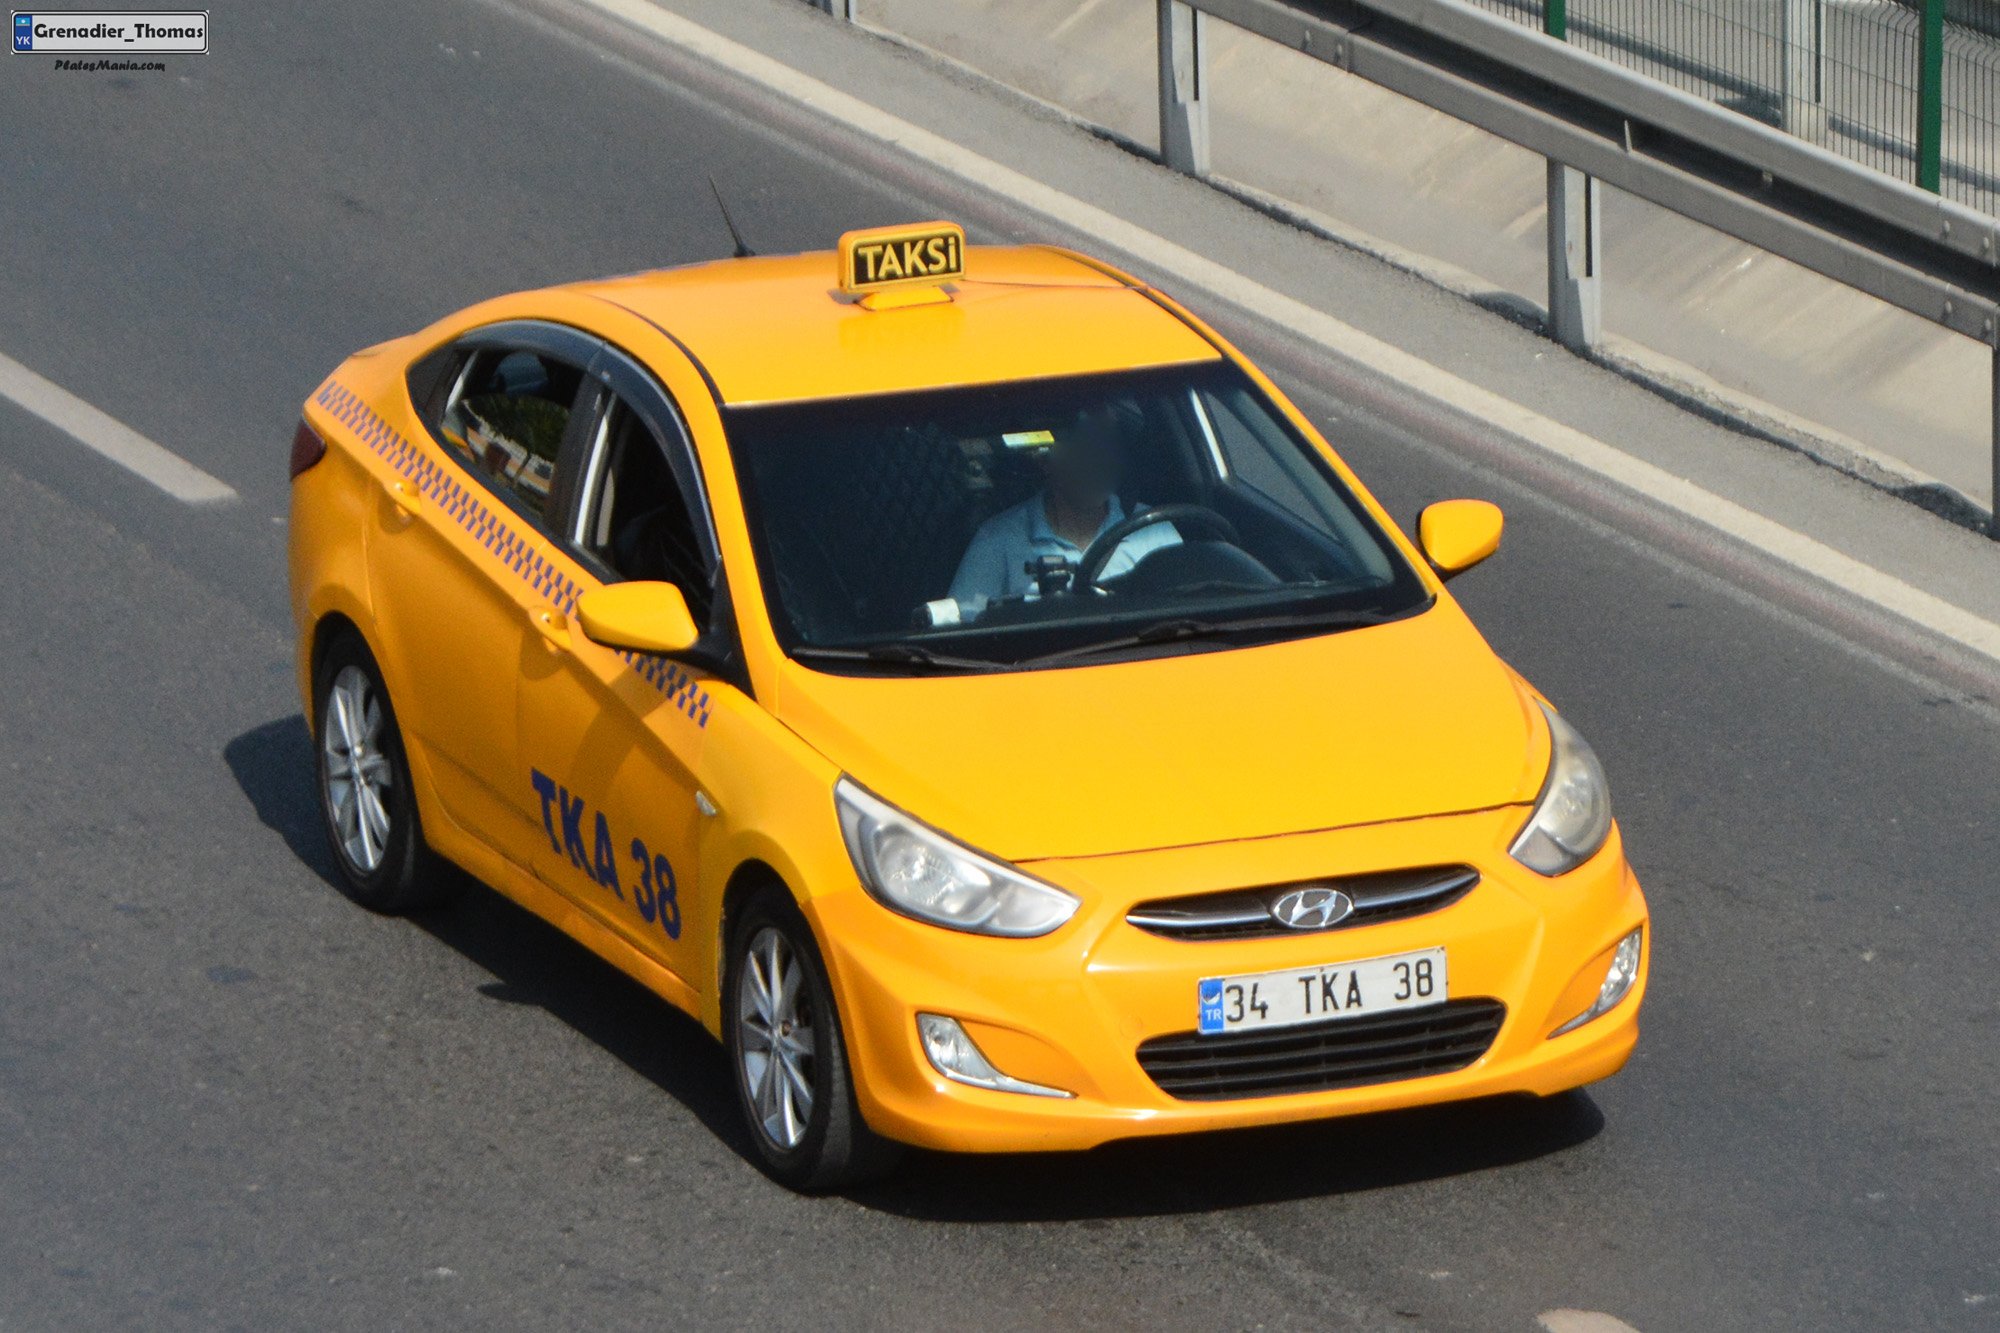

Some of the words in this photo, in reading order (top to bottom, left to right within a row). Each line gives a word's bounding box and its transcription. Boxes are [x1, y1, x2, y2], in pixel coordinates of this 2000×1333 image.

[531, 767, 625, 901] TKA
[631, 837, 682, 940] 38
[1205, 1009, 1222, 1021] TR
[1225, 983, 1269, 1023] 34
[1298, 970, 1363, 1015] TKA
[1393, 958, 1433, 1001] 38
